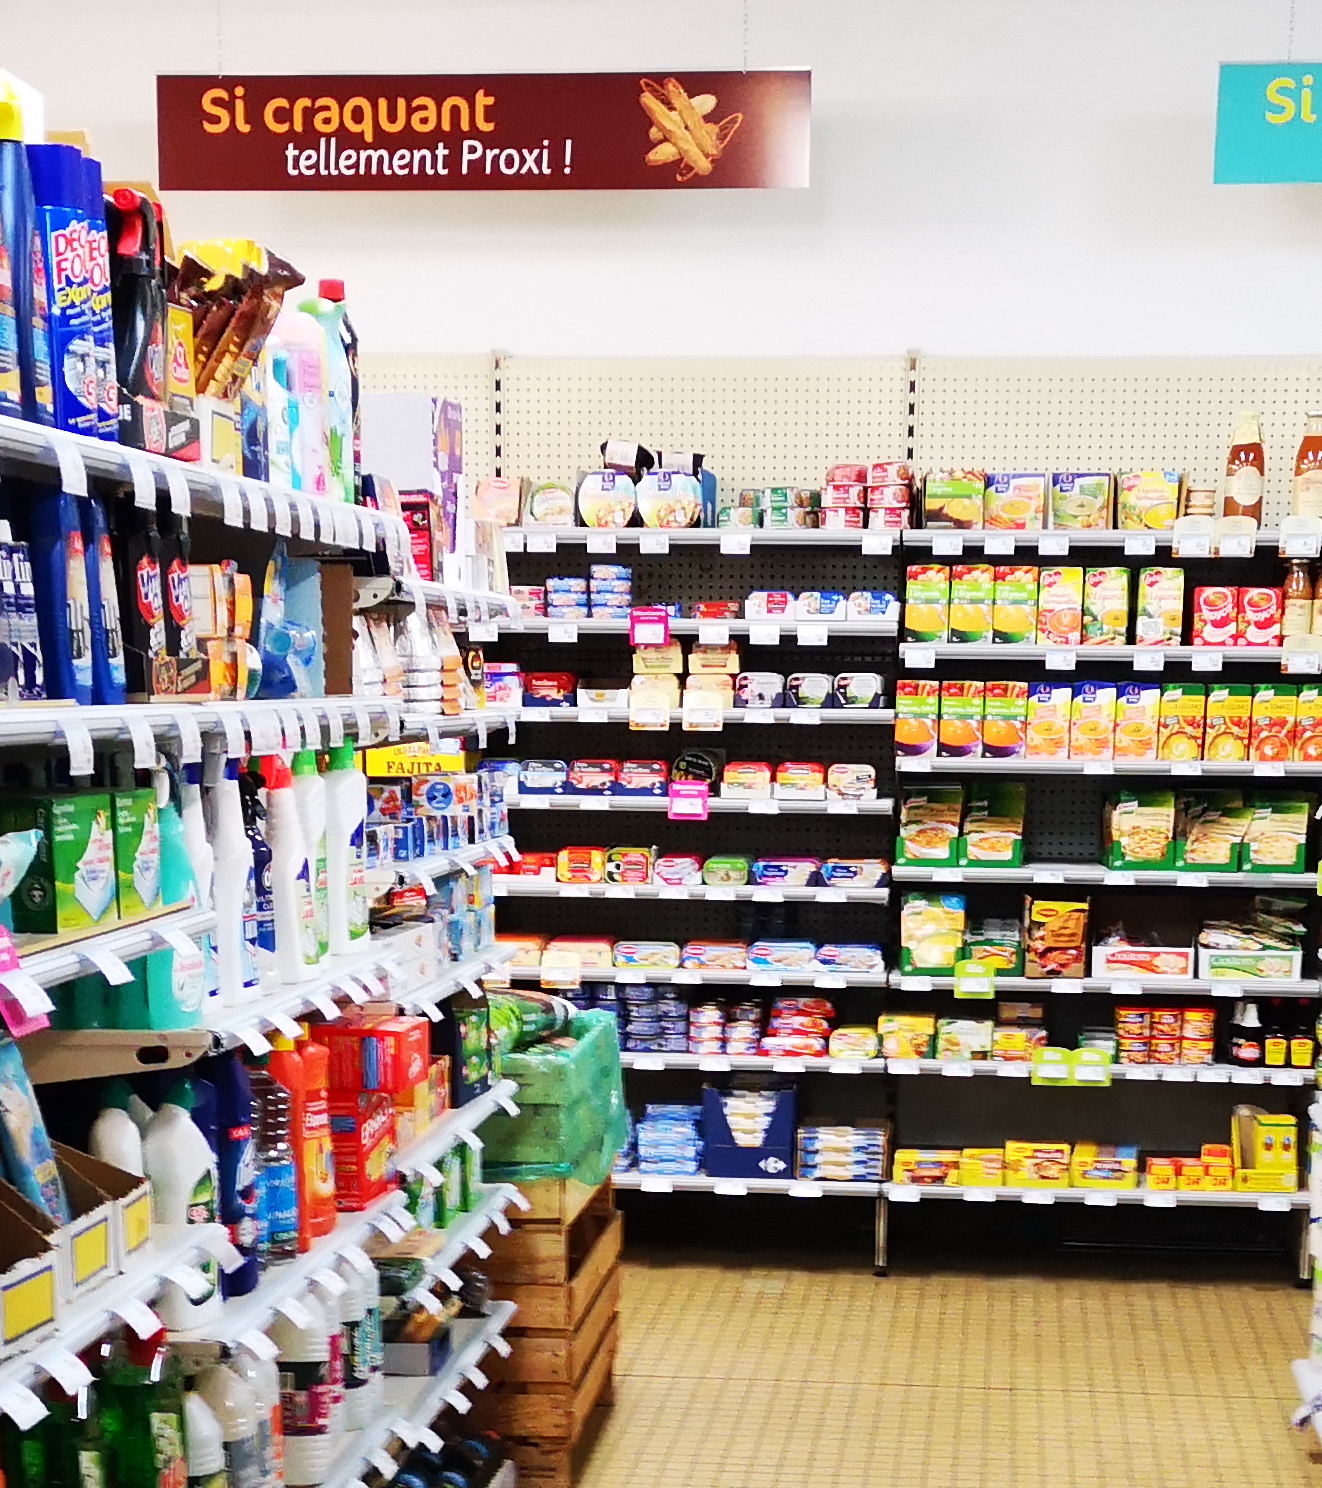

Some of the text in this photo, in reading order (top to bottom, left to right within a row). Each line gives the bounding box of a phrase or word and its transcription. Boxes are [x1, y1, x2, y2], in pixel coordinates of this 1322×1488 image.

[201, 87, 495, 142] Si craquant
[1264, 76, 1316, 124] Si
[285, 138, 574, 178] tellement Proxi !
[385, 760, 443, 775] FAJITA
